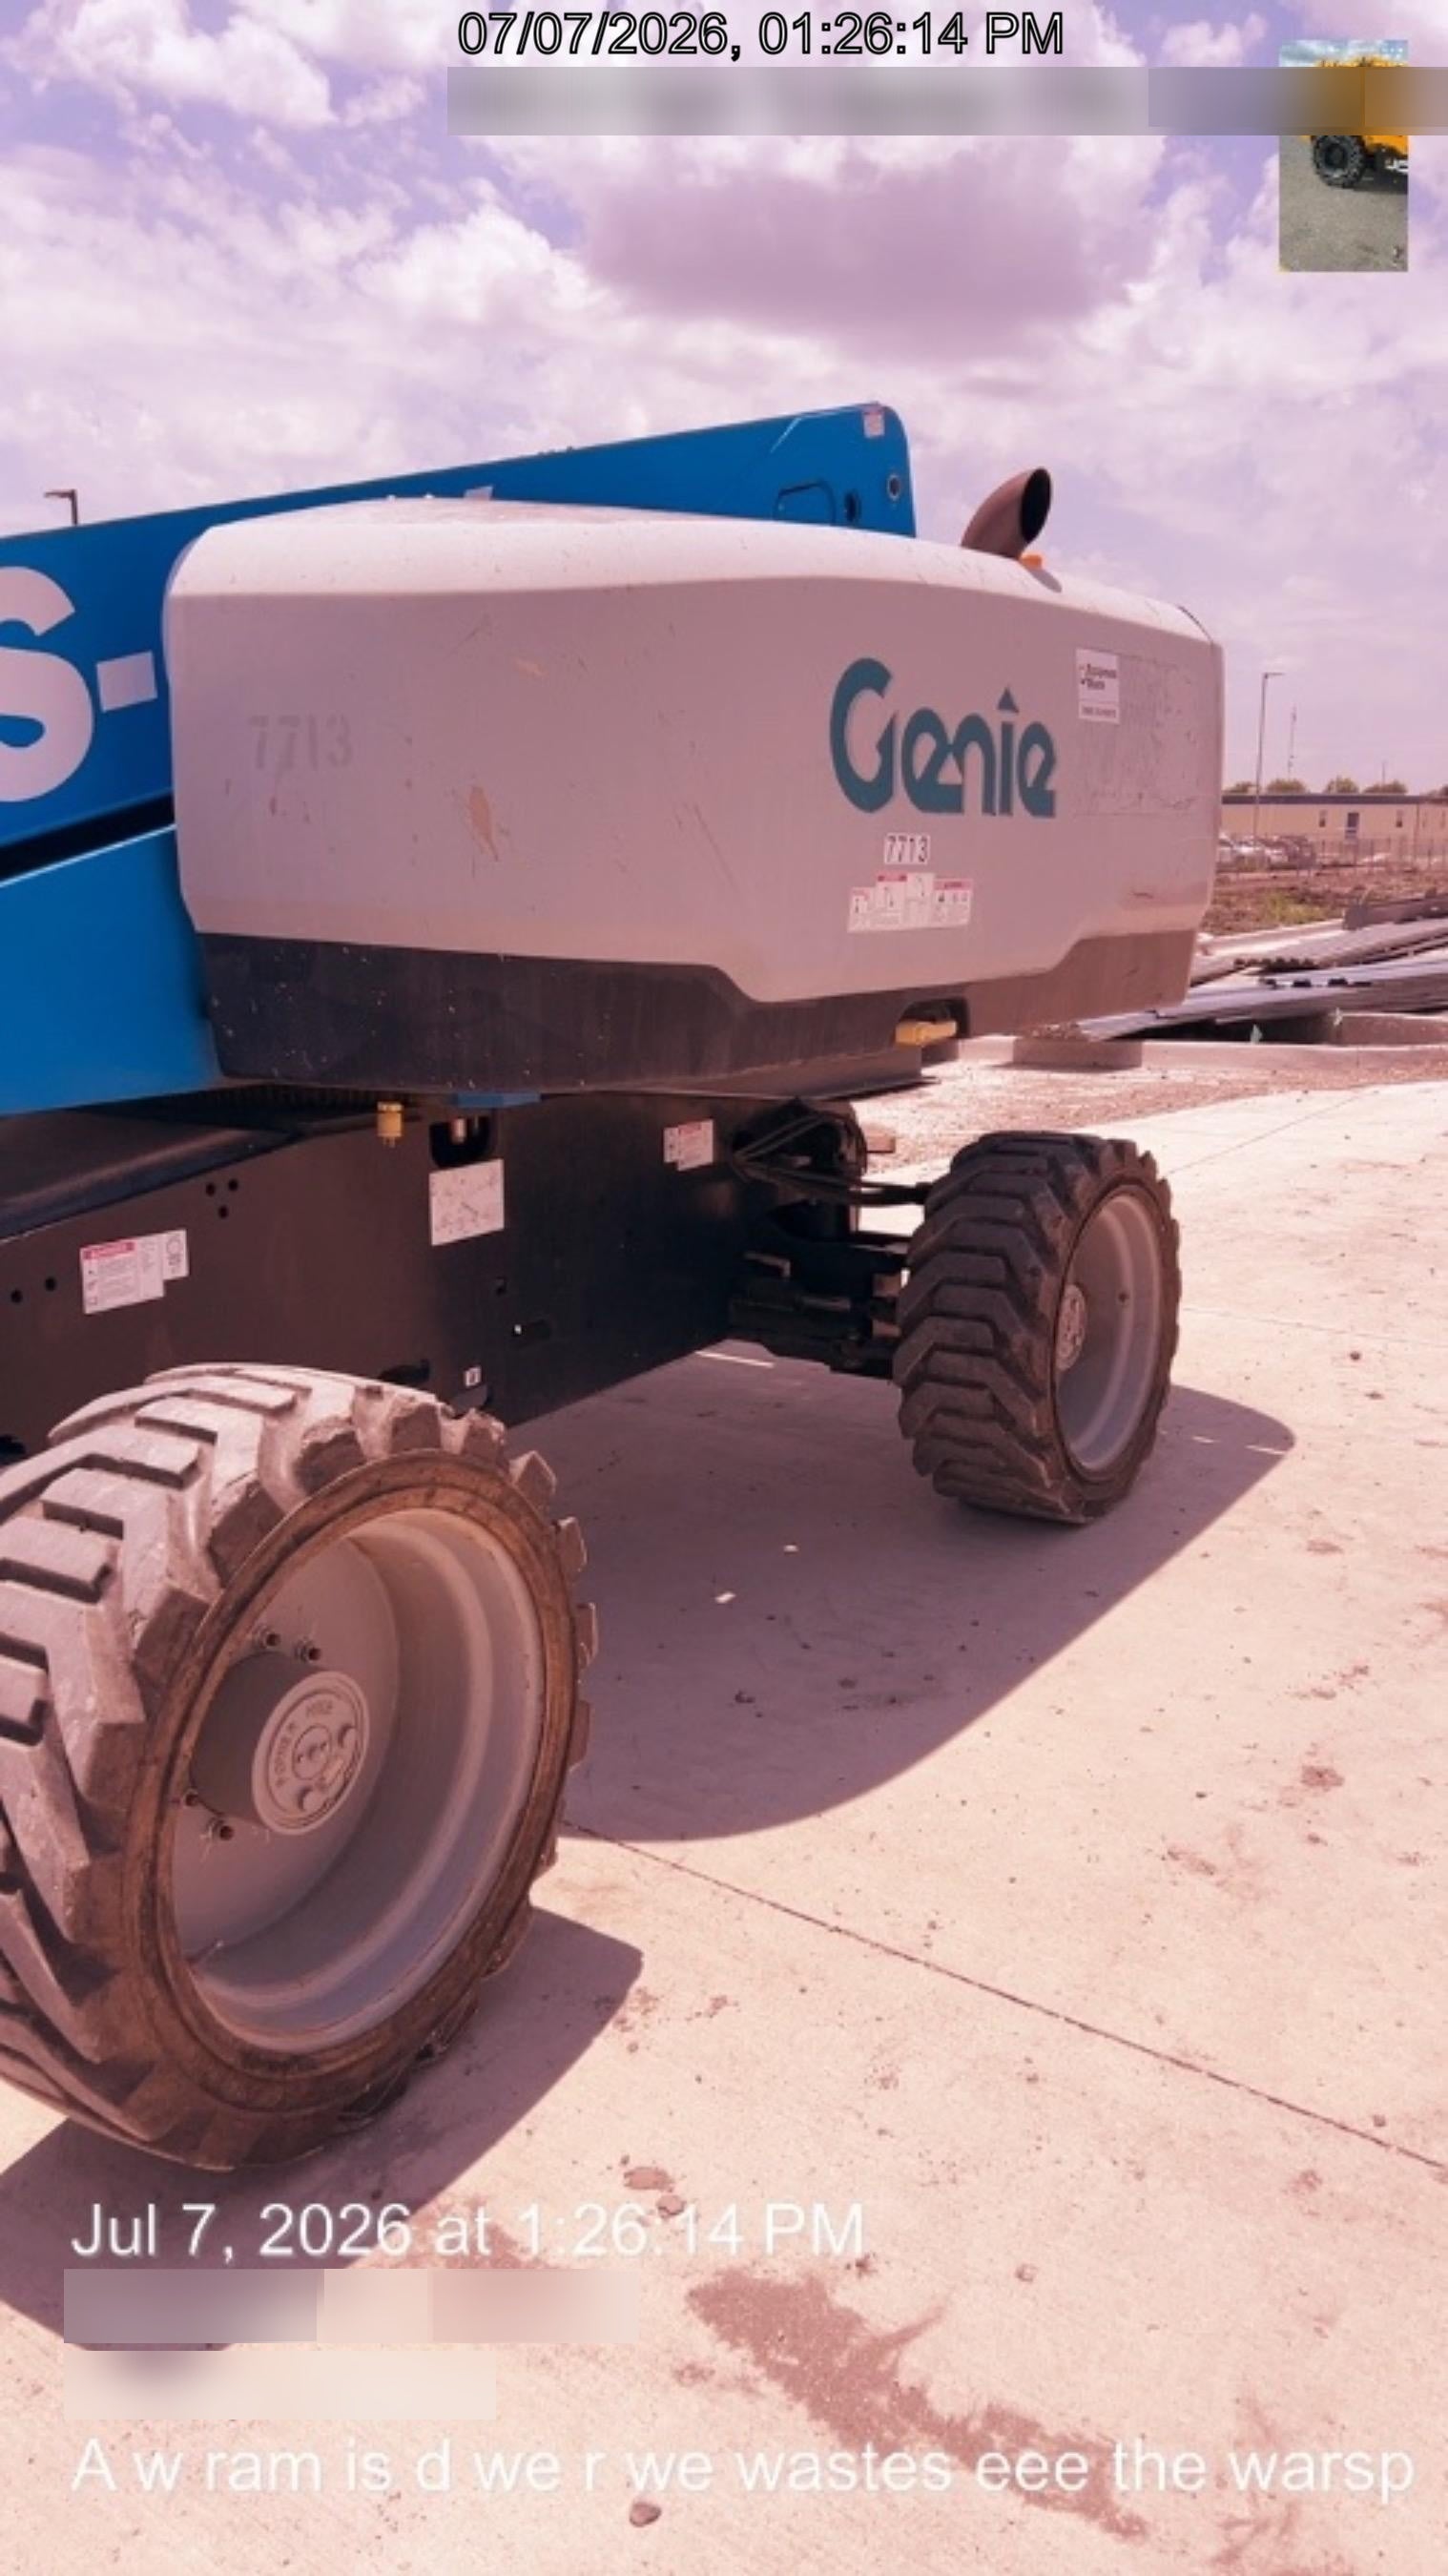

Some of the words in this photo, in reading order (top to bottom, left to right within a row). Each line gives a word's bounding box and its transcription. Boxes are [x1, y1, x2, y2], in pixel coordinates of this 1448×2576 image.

[247, 714, 354, 770] 7713
[829, 656, 1057, 819] Genie
[886, 835, 928, 862] 7713
